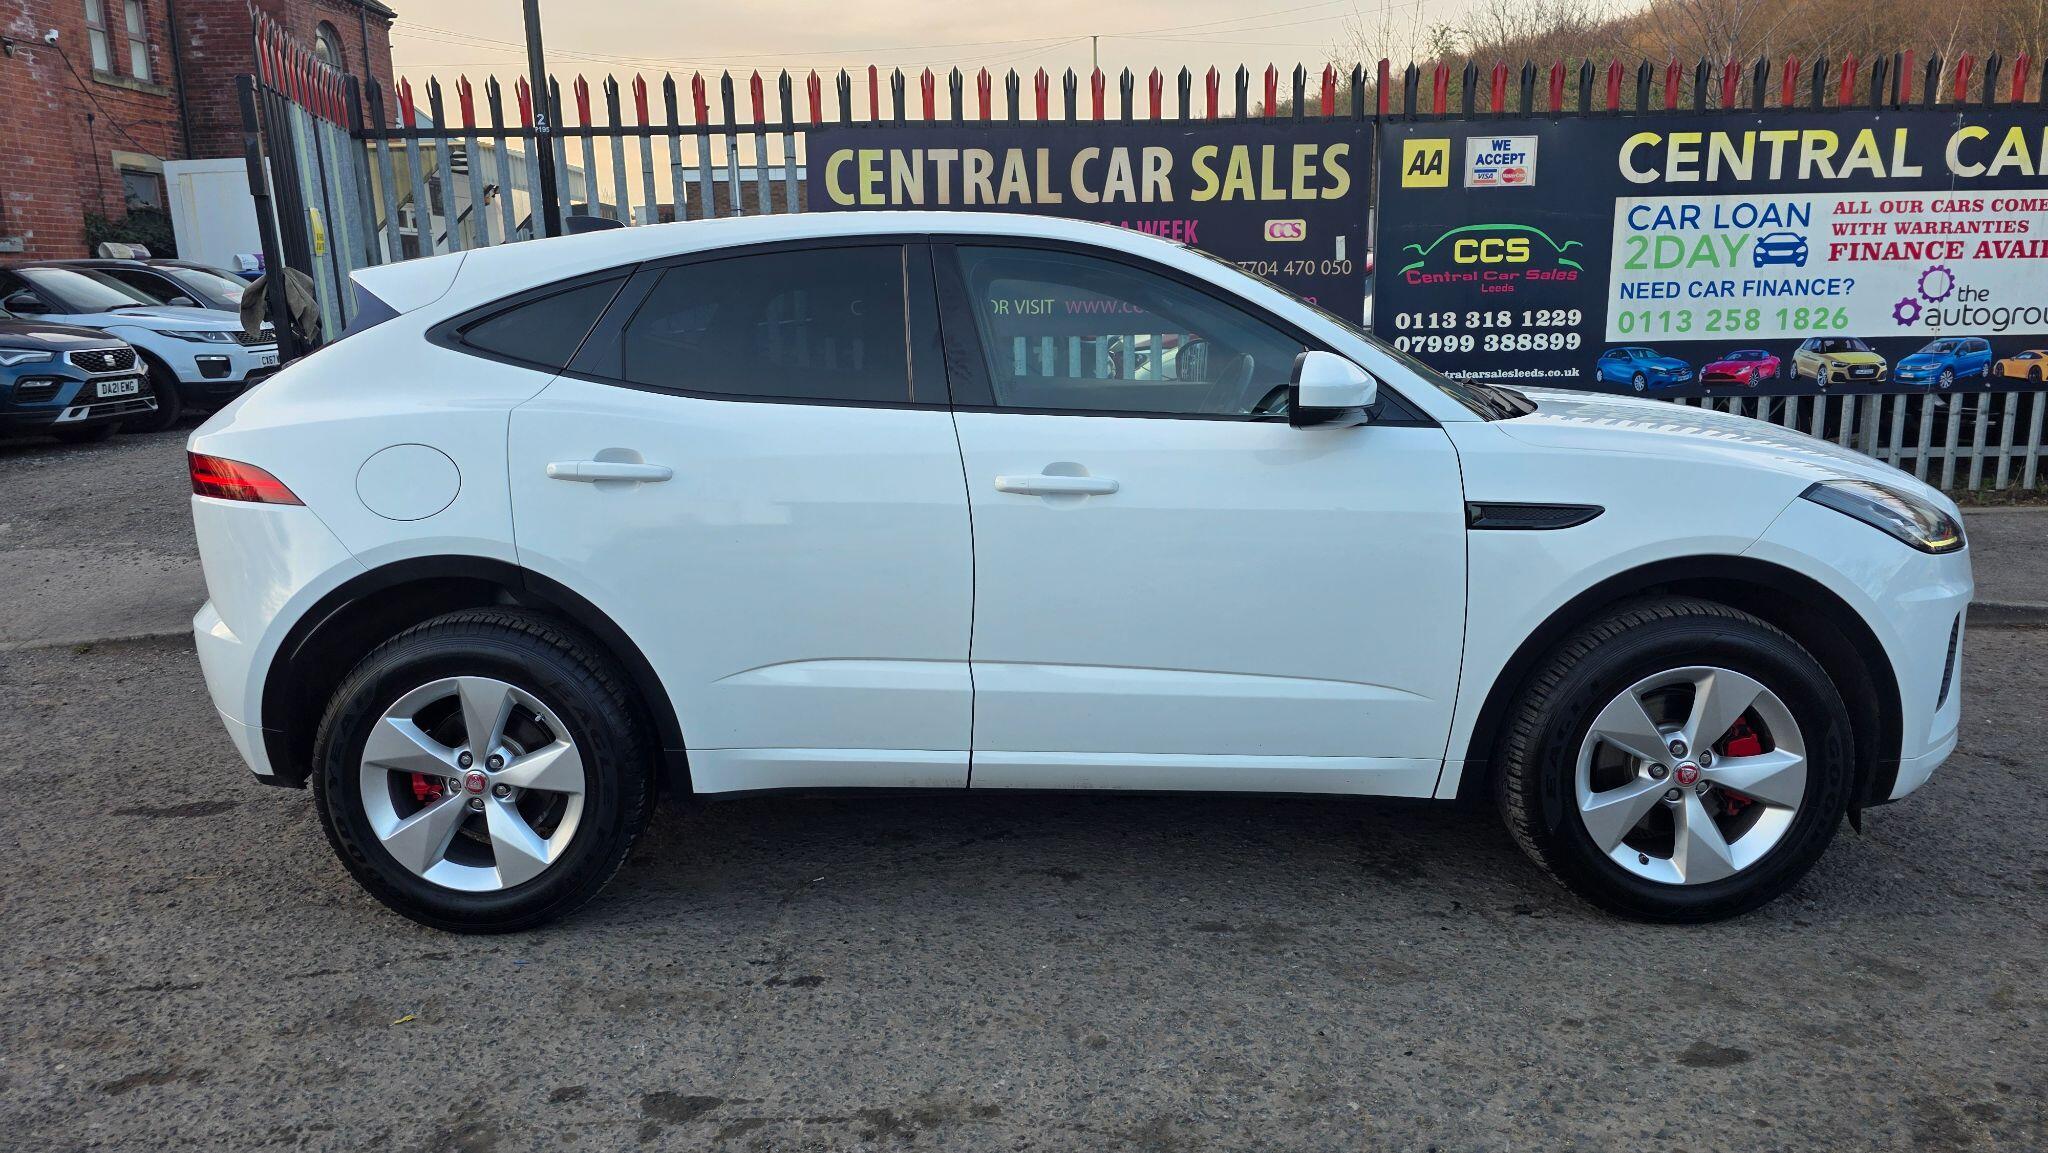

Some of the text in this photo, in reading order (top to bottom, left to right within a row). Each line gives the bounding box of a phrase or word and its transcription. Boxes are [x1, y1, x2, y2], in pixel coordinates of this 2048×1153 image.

[536, 113, 546, 126] 2
[1491, 139, 1512, 151] WE
[1407, 150, 1443, 175] AA
[1475, 153, 1526, 165] ACCEPT
[1618, 128, 1922, 184] CENTRAL
[825, 143, 1350, 204] CENTRAL CAR SALES
[1832, 198, 2048, 214] ALL OUR CARS COME
[1628, 202, 1811, 230] CAR LOAN
[1137, 219, 1198, 244] WEEK
[1269, 222, 1301, 238] CCS
[1832, 220, 2030, 236] WITH WARRANTIES
[1454, 237, 1530, 263] CCS
[1624, 233, 1750, 270] 2DAY
[1828, 240, 1965, 261] FINANCE
[1284, 260, 1315, 275] 470
[1321, 259, 1352, 275] 050
[1406, 269, 1577, 285] Central Car Sales
[1481, 283, 1514, 292] Leeds
[1620, 278, 1855, 299] NEED CAR FINANCE?
[1958, 284, 1990, 302] the
[1014, 299, 1055, 314] VISIT
[1395, 309, 1582, 330] 0113 318 1229
[1618, 307, 1849, 334] 0113 258 1826
[1394, 332, 1581, 352] 07999 388899
[101, 382, 119, 395] DA21
